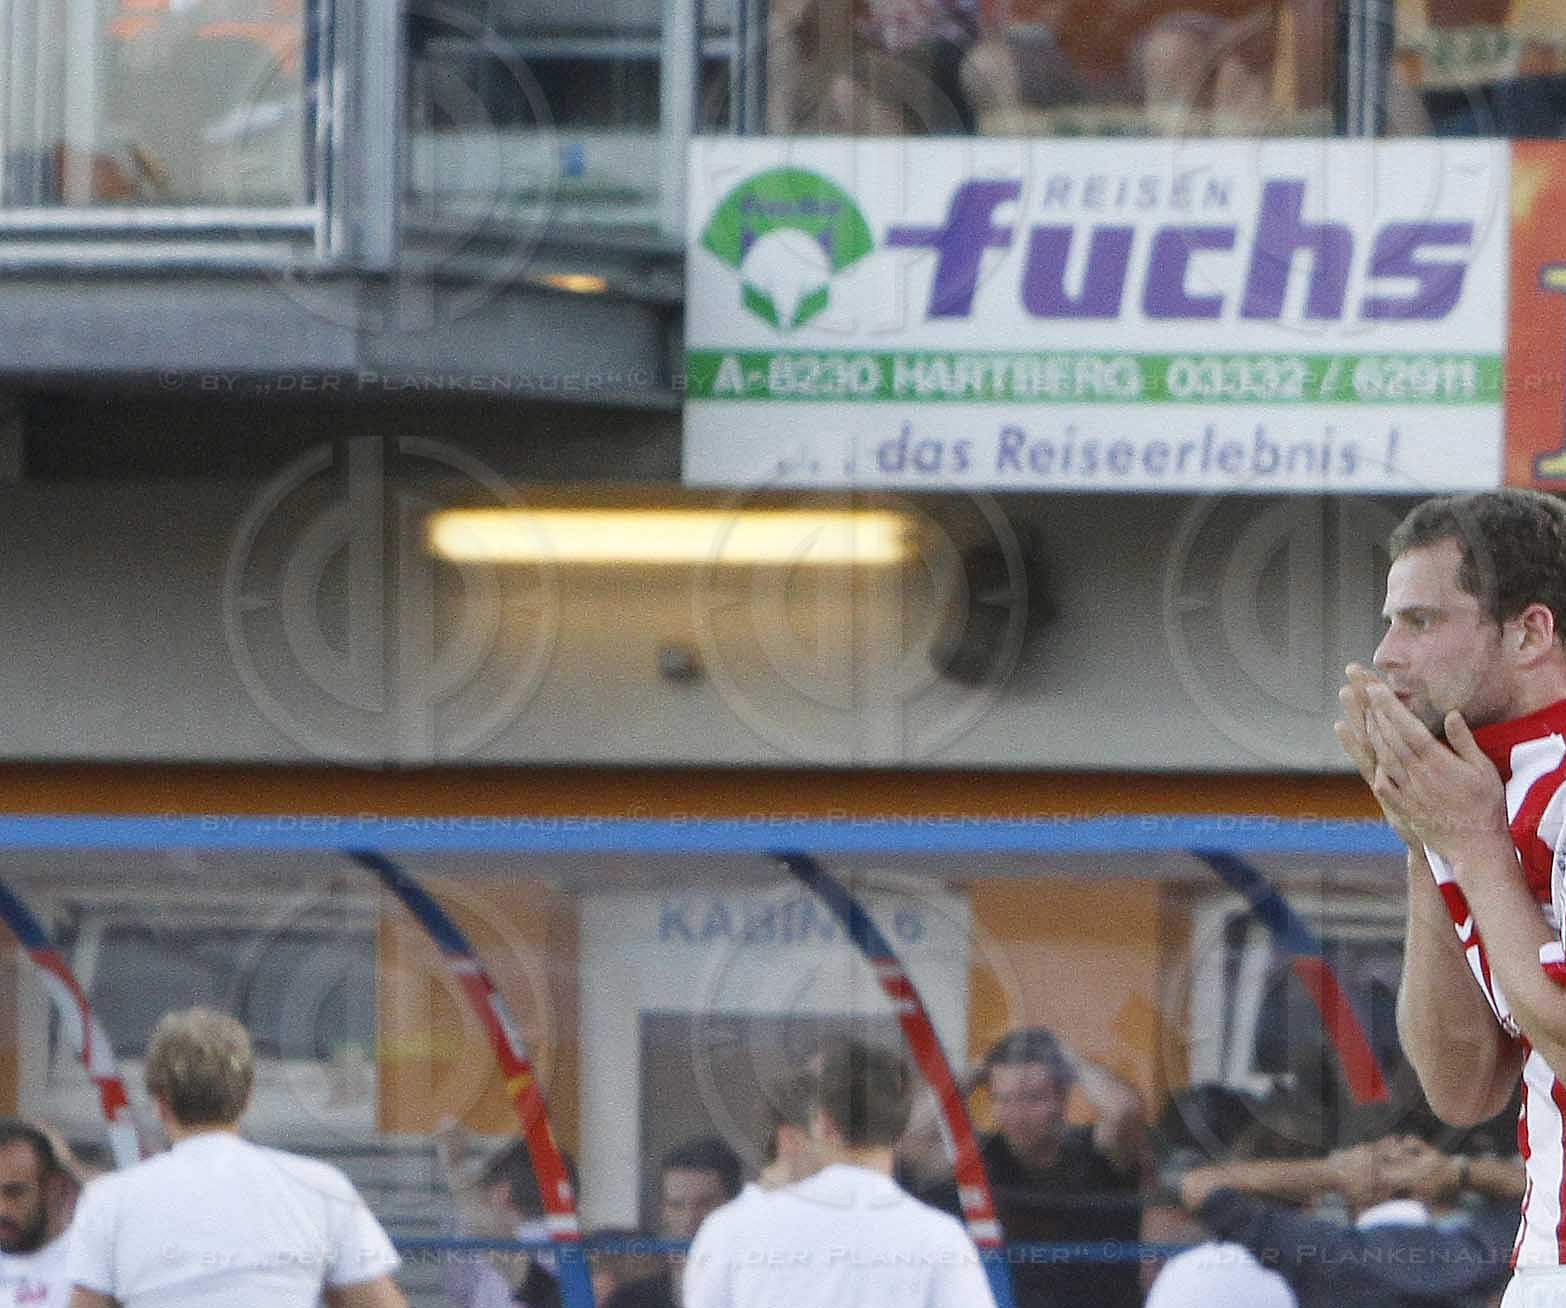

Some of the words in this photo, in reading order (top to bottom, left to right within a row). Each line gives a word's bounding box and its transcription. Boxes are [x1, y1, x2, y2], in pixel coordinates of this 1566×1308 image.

[1042, 176, 1232, 210] REISEN
[884, 178, 1476, 321] fuchs
[876, 419, 973, 476] das
[997, 421, 1360, 477] Reiseerlebnis
